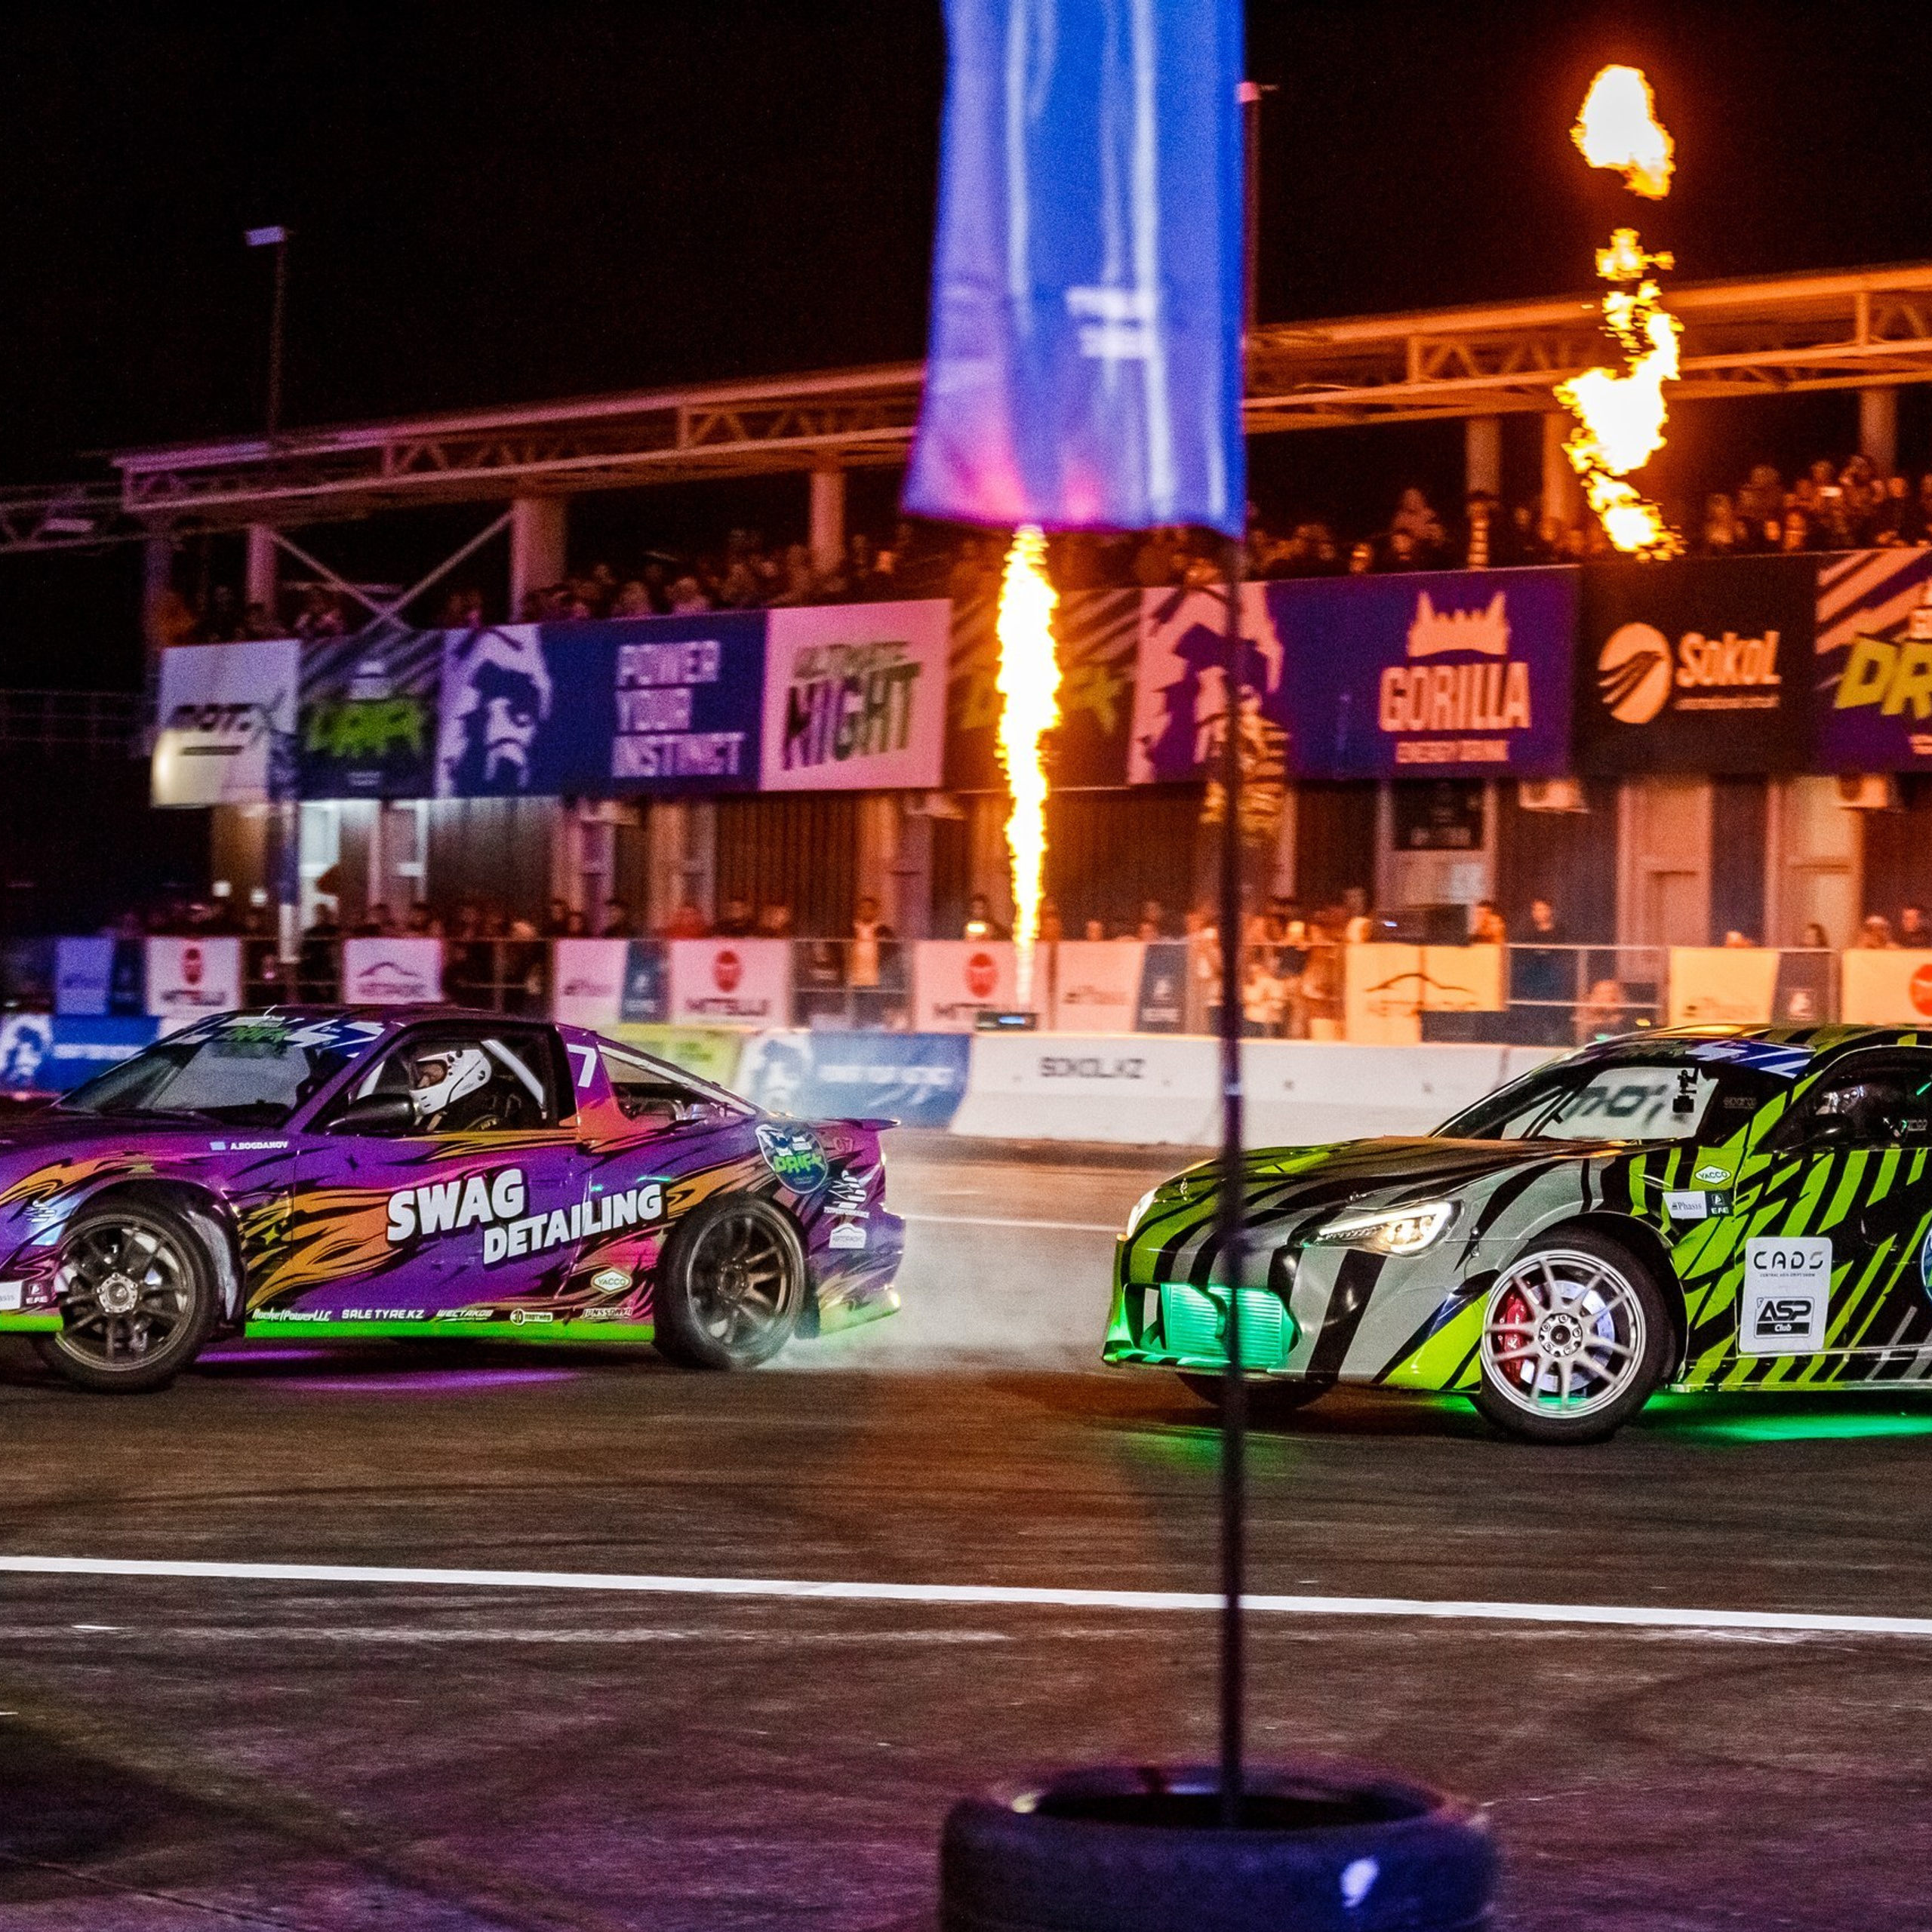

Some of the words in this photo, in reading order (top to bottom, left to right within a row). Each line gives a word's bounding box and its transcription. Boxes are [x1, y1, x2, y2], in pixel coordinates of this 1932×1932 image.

[1675, 631, 1782, 688] Sokol
[783, 661, 921, 770] NIGHT
[1379, 662, 1531, 731] GORILLA
[567, 1043, 598, 1088] 7
[387, 1169, 525, 1241] SWAG
[483, 1184, 663, 1264] DETAILING
[1753, 1251, 1824, 1269] CADS
[342, 1309, 373, 1319] SALE
[1758, 1300, 1812, 1321] ASP
[1774, 1324, 1792, 1332] Club
